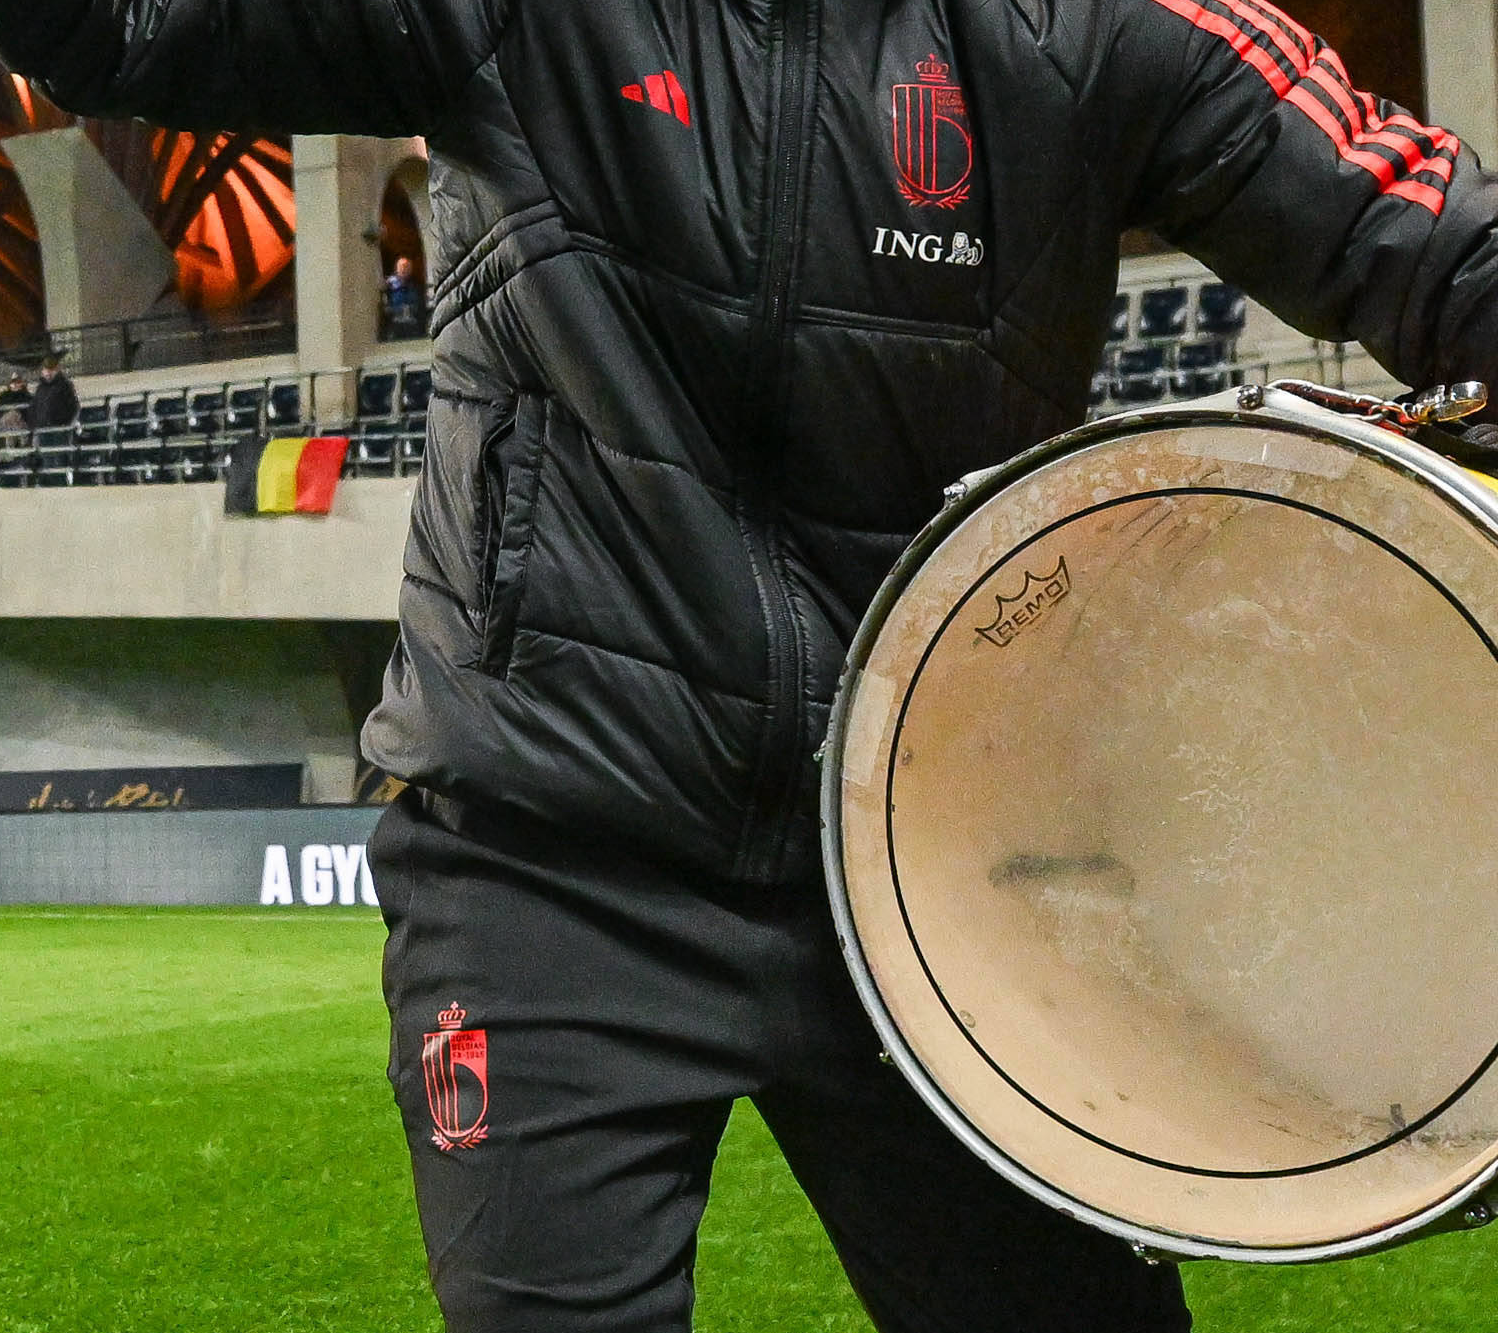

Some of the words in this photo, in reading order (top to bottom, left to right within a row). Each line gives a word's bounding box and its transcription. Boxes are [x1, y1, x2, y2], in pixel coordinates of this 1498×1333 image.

[872, 226, 944, 263] ING
[996, 579, 1064, 639] REMO
[260, 844, 294, 905] A
